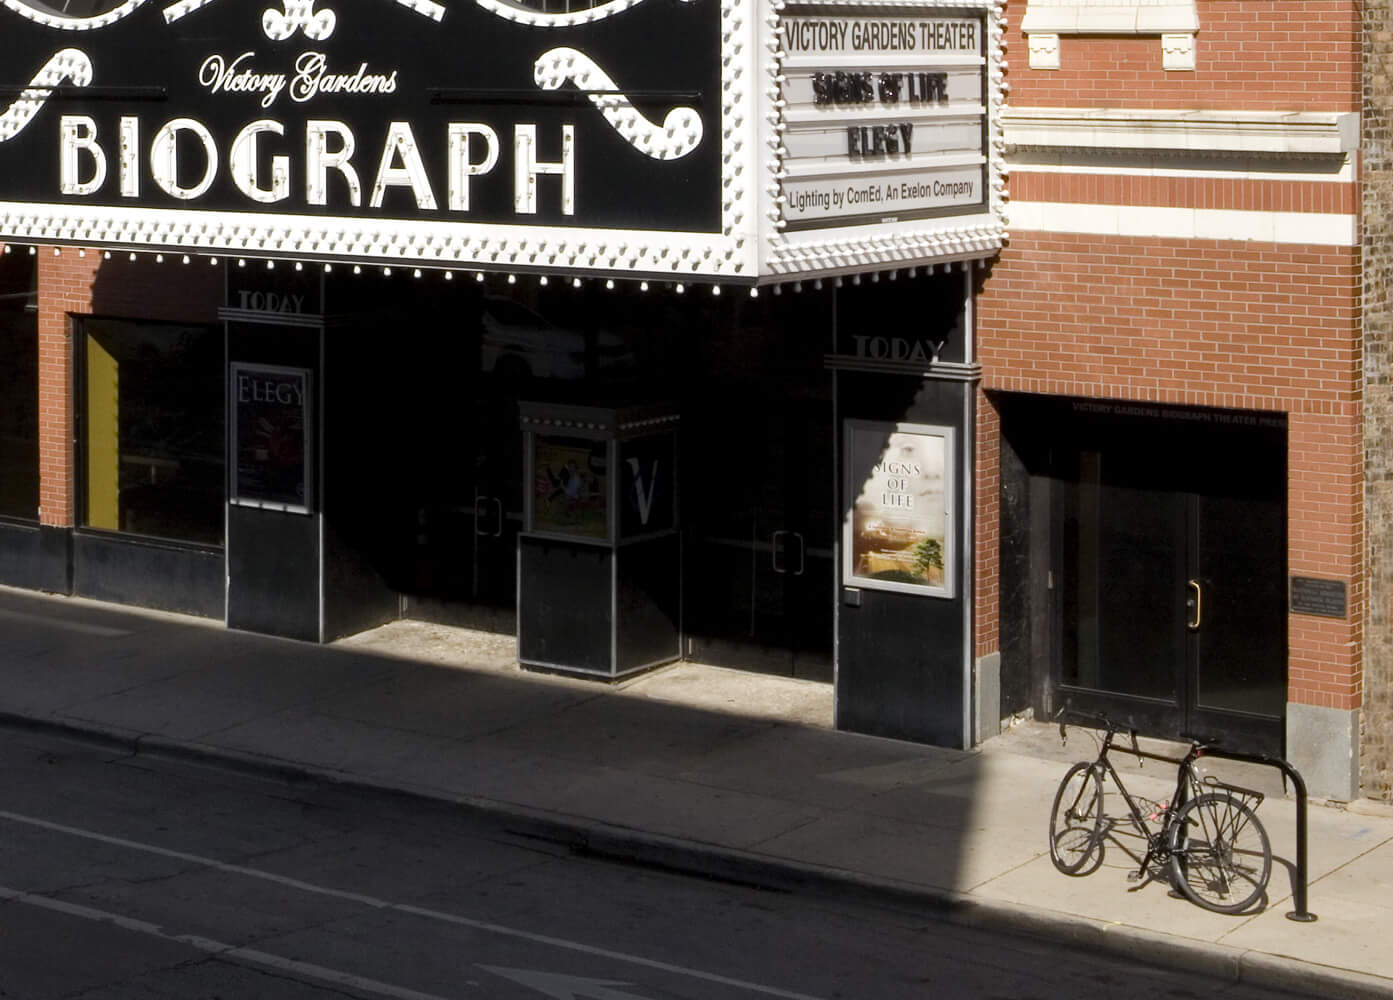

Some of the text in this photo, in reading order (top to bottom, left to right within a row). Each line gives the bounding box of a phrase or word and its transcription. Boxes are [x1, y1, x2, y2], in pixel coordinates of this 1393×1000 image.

[785, 21, 975, 51] VICTORY GARDENS THEATER
[199, 52, 398, 108] Victory Gardens
[812, 71, 875, 105] SIGNS
[907, 72, 949, 104] LIFE
[847, 122, 914, 158] ELEGY
[59, 115, 576, 216] BIOGRAPH
[789, 189, 830, 212] Lighting
[832, 188, 844, 207] by
[886, 184, 899, 201] An
[901, 182, 931, 200] Exelon
[933, 180, 974, 201] Company
[238, 289, 305, 313] TODAY
[851, 334, 944, 362] TODAY
[239, 375, 303, 406] ELEGY
[873, 462, 921, 475] SIGNS
[887, 479, 906, 490] OF
[882, 493, 913, 507] LIFE
